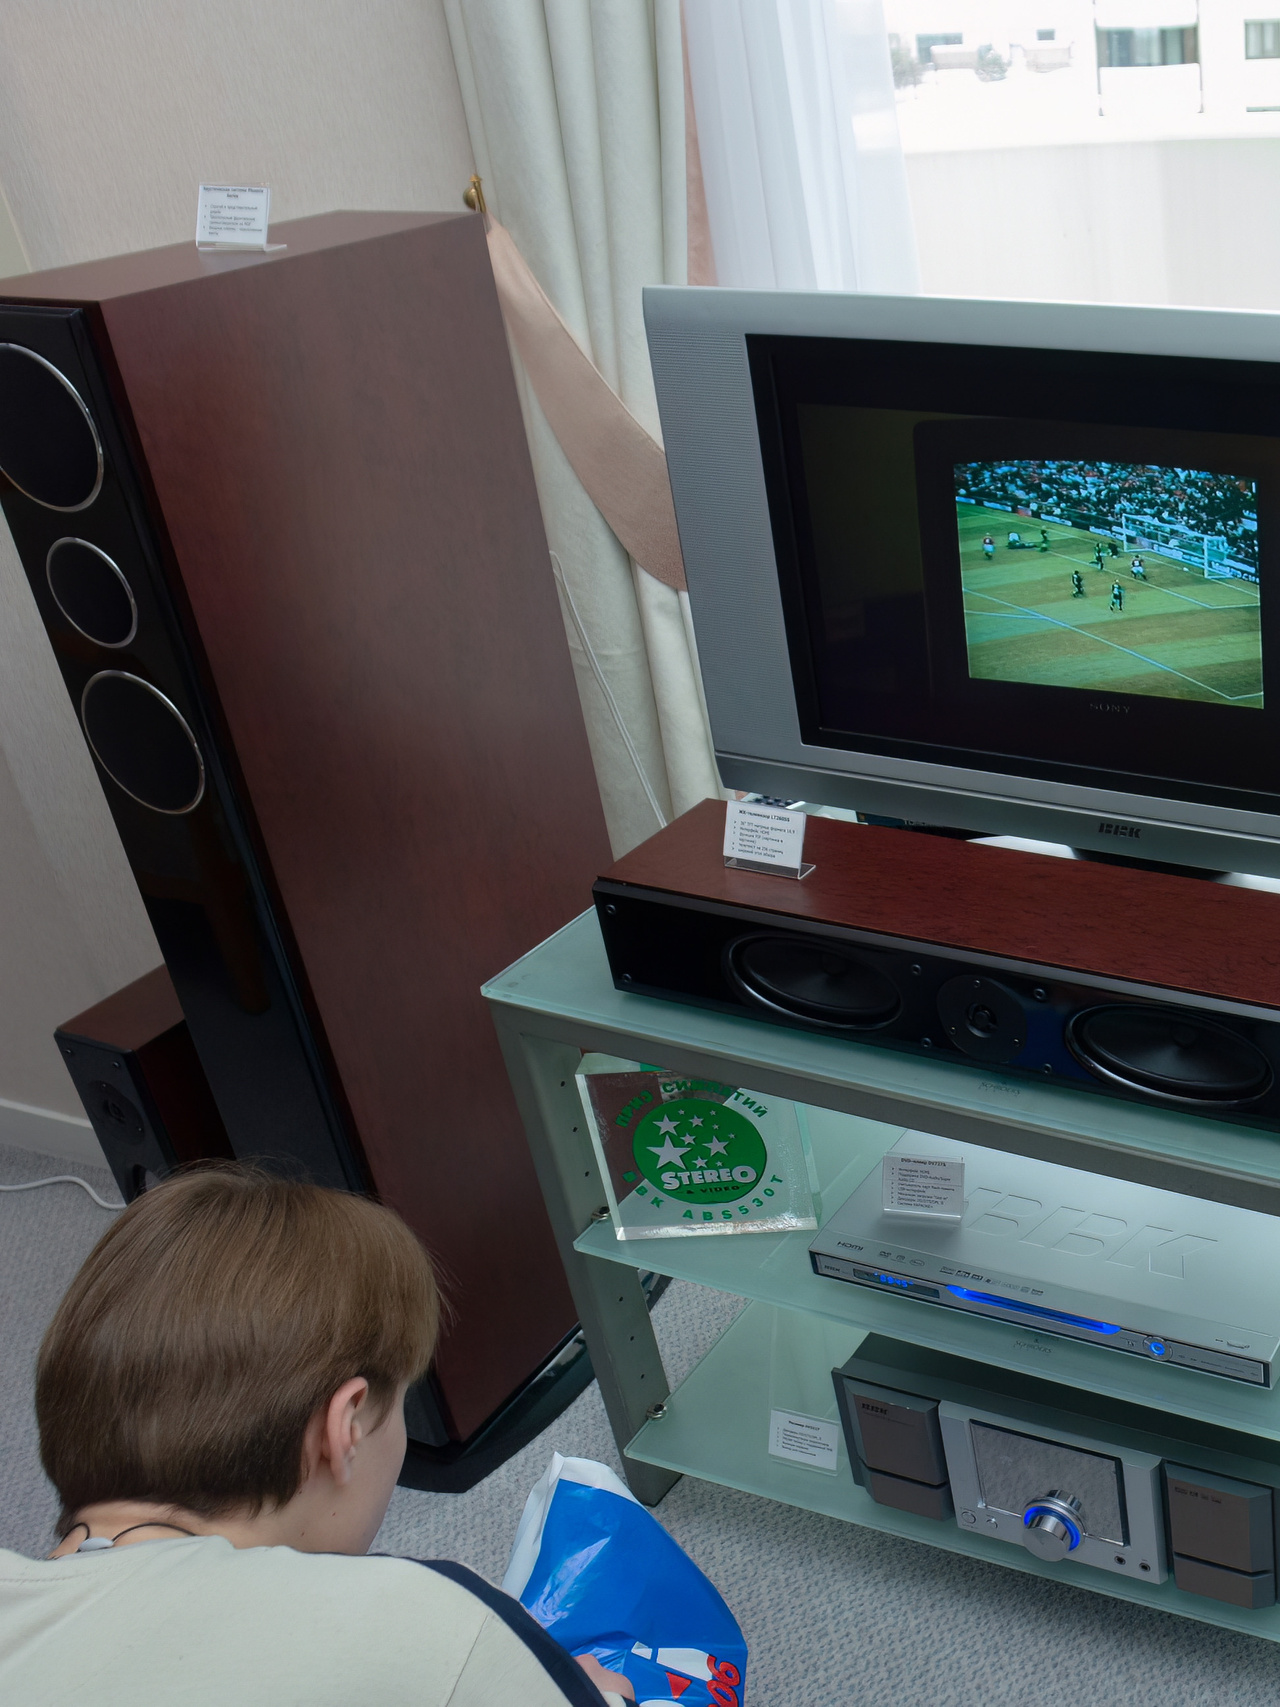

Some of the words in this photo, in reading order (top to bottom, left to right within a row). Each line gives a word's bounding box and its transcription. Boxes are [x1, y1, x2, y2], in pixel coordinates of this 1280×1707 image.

[1098, 822, 1142, 839] BBK
[615, 1089, 654, 1128] ПРИЗ
[661, 1079, 769, 1118] СИМПАТИЙ
[660, 1165, 757, 1191] STEREO
[699, 1185, 740, 1195] VIDEO
[682, 1174, 784, 1222] ABS530T
[837, 1241, 864, 1251] HDMI
[964, 1186, 1219, 1280] BBK
